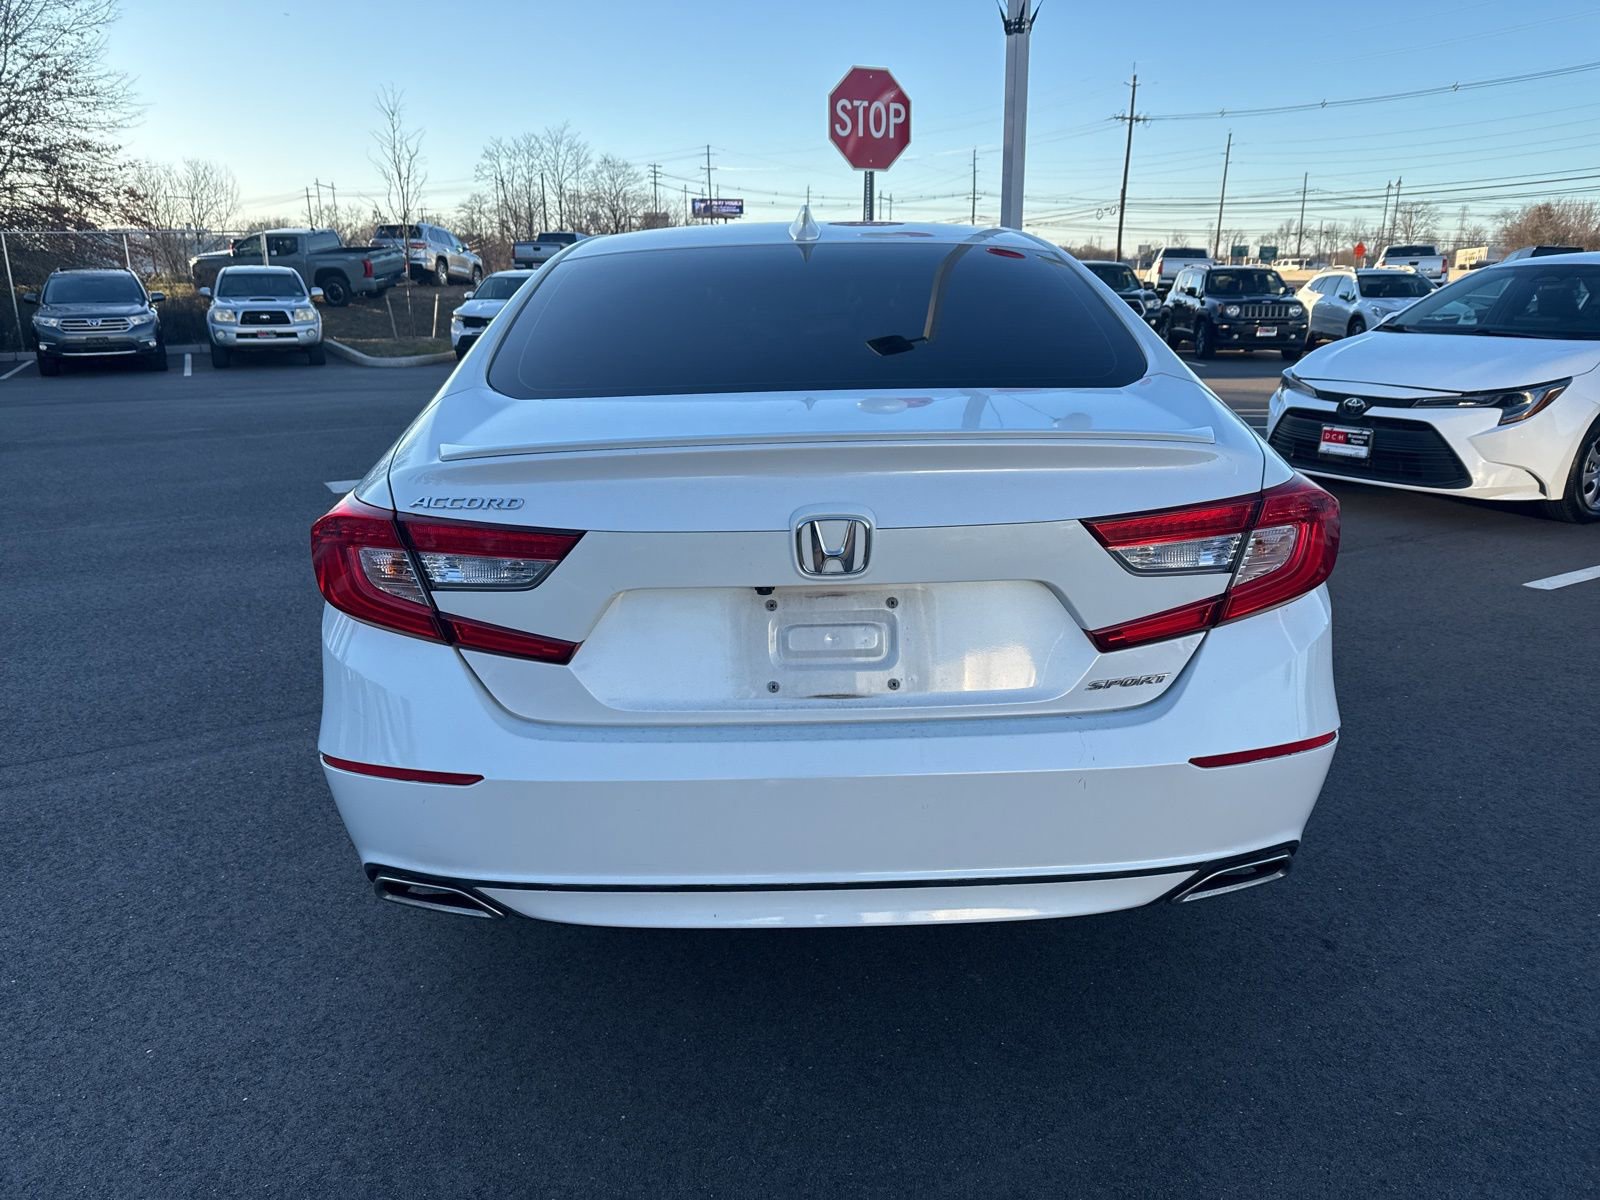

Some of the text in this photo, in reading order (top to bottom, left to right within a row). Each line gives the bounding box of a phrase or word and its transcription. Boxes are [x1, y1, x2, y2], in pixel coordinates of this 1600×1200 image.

[835, 98, 906, 139] STOP
[409, 496, 525, 510] ACCORD
[1085, 672, 1171, 690] SPORT
